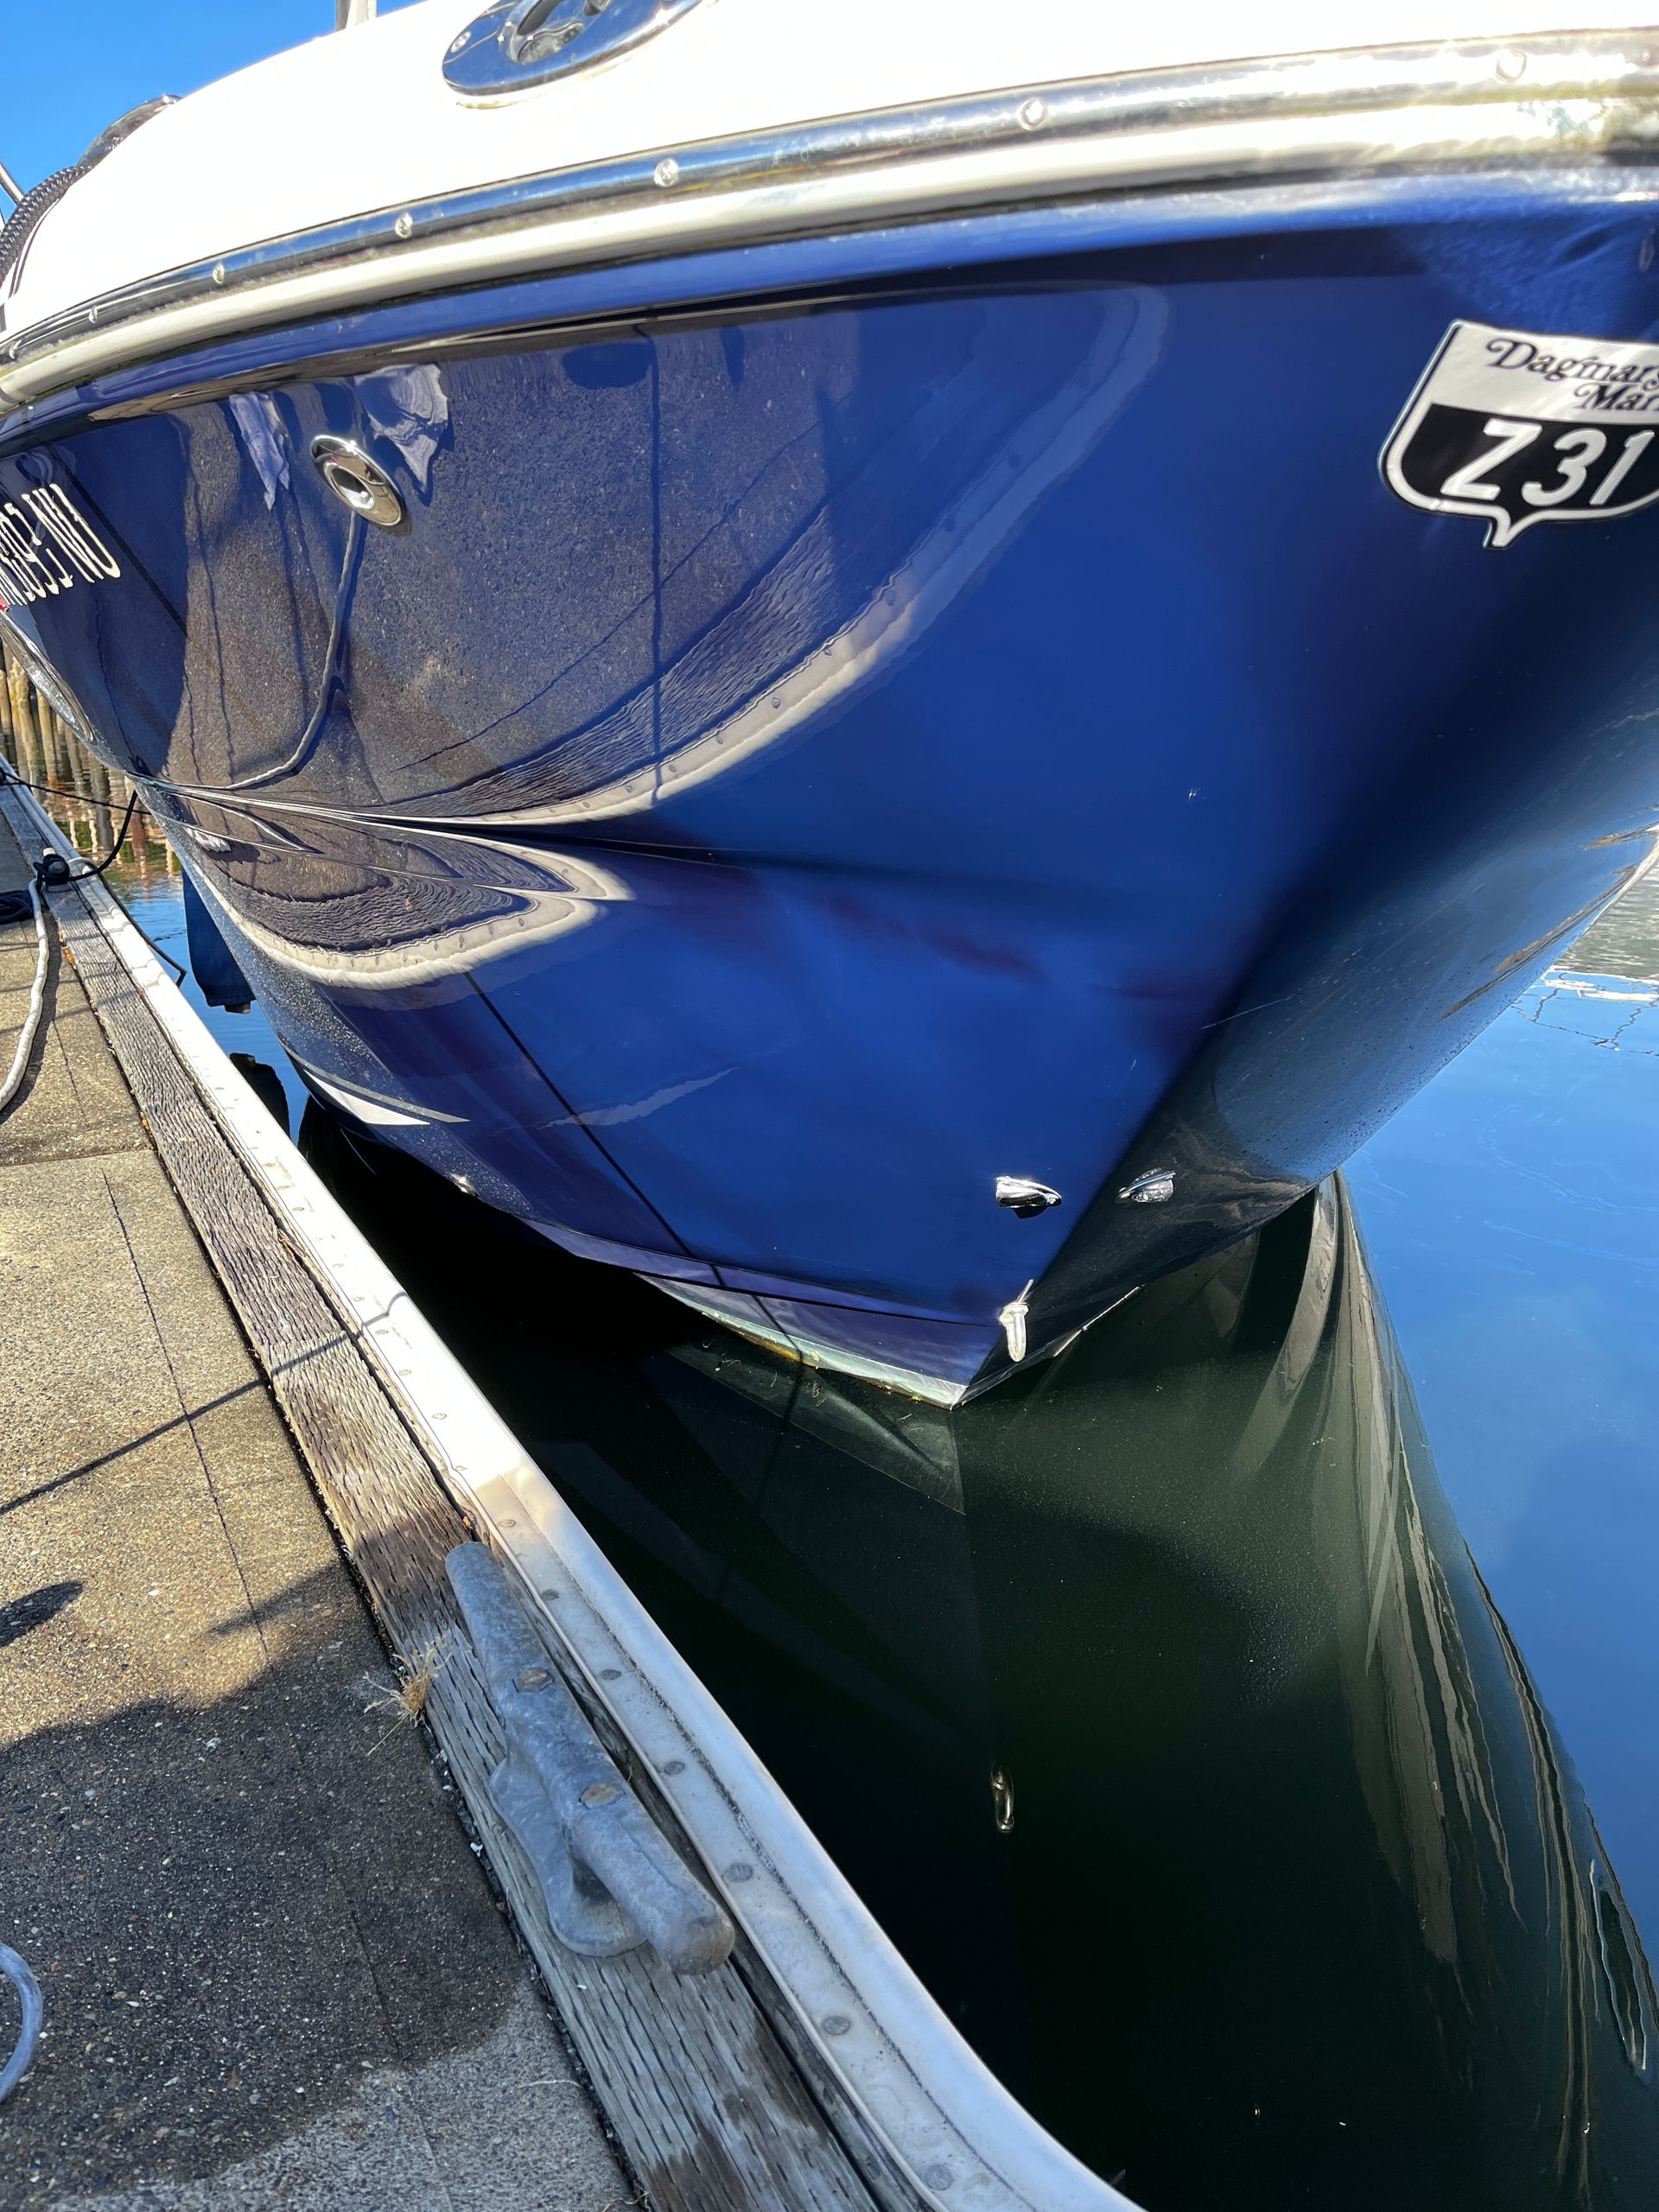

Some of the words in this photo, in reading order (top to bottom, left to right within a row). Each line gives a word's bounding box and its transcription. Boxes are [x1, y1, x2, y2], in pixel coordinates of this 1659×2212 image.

[1573, 382, 1659, 411] Mar
[1440, 418, 1656, 506] Z31
[21, 483, 121, 583] NU
